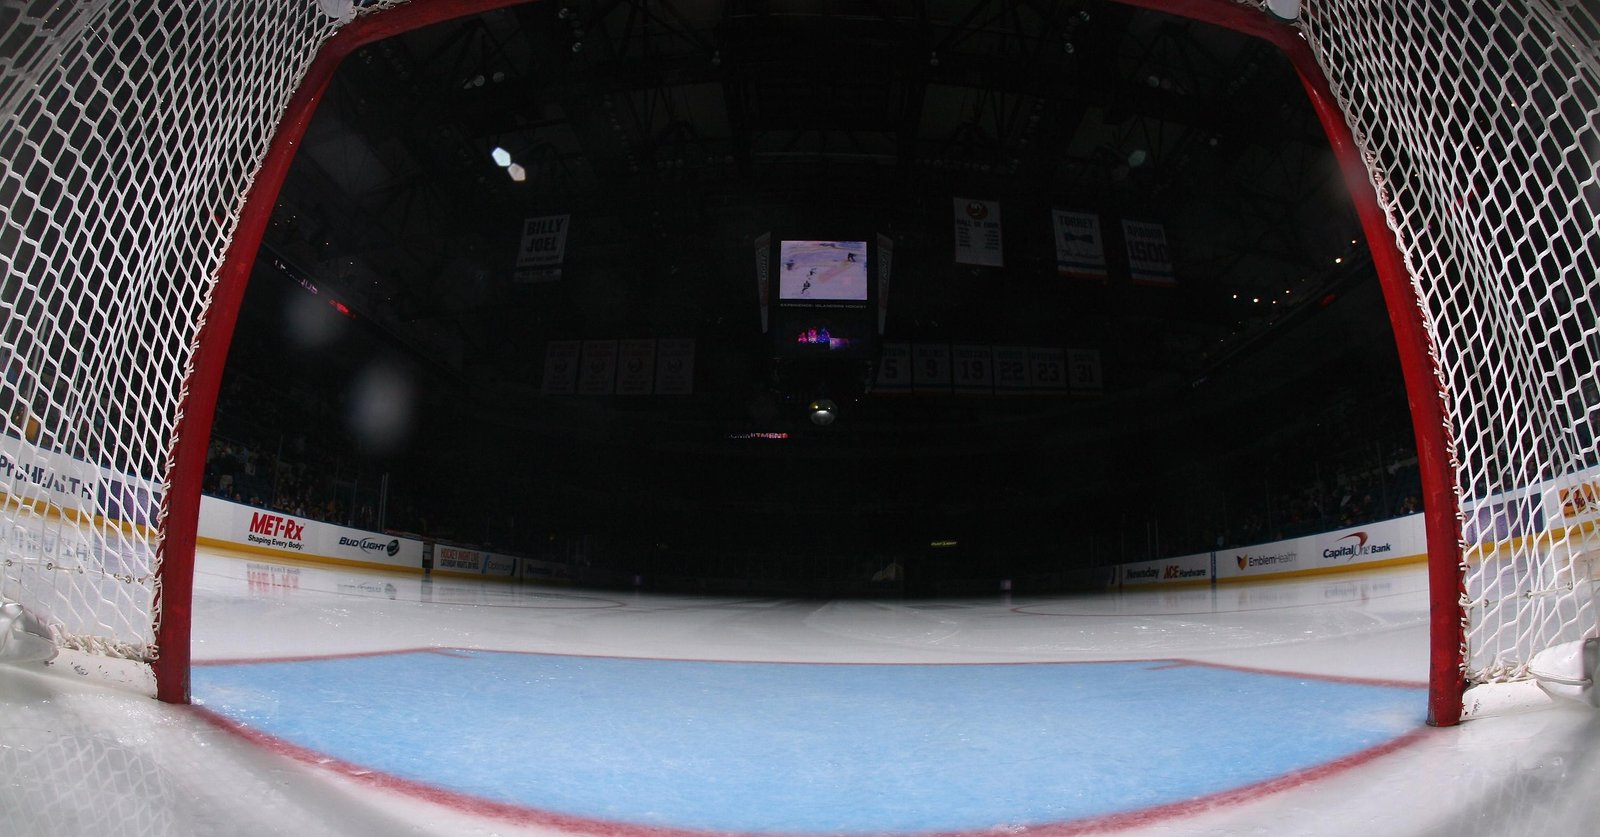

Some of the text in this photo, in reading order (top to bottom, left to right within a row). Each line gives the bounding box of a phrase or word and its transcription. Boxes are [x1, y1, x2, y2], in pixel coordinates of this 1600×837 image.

[527, 217, 564, 236] BILLY
[526, 236, 557, 252] JOEL
[884, 359, 898, 378] 5
[927, 359, 938, 377] 9
[961, 360, 984, 379] 19
[1000, 361, 1024, 381] 22
[1039, 362, 1059, 381] 23
[248, 534, 271, 546] Shaping
[272, 538, 288, 549] Every
[339, 536, 386, 551] BUD LIGHT
[1371, 543, 1391, 554] Bank
[1249, 552, 1297, 567] EmblemHealth
[1127, 566, 1160, 579] Newsday
[1163, 565, 1206, 579] ACE Hardware
